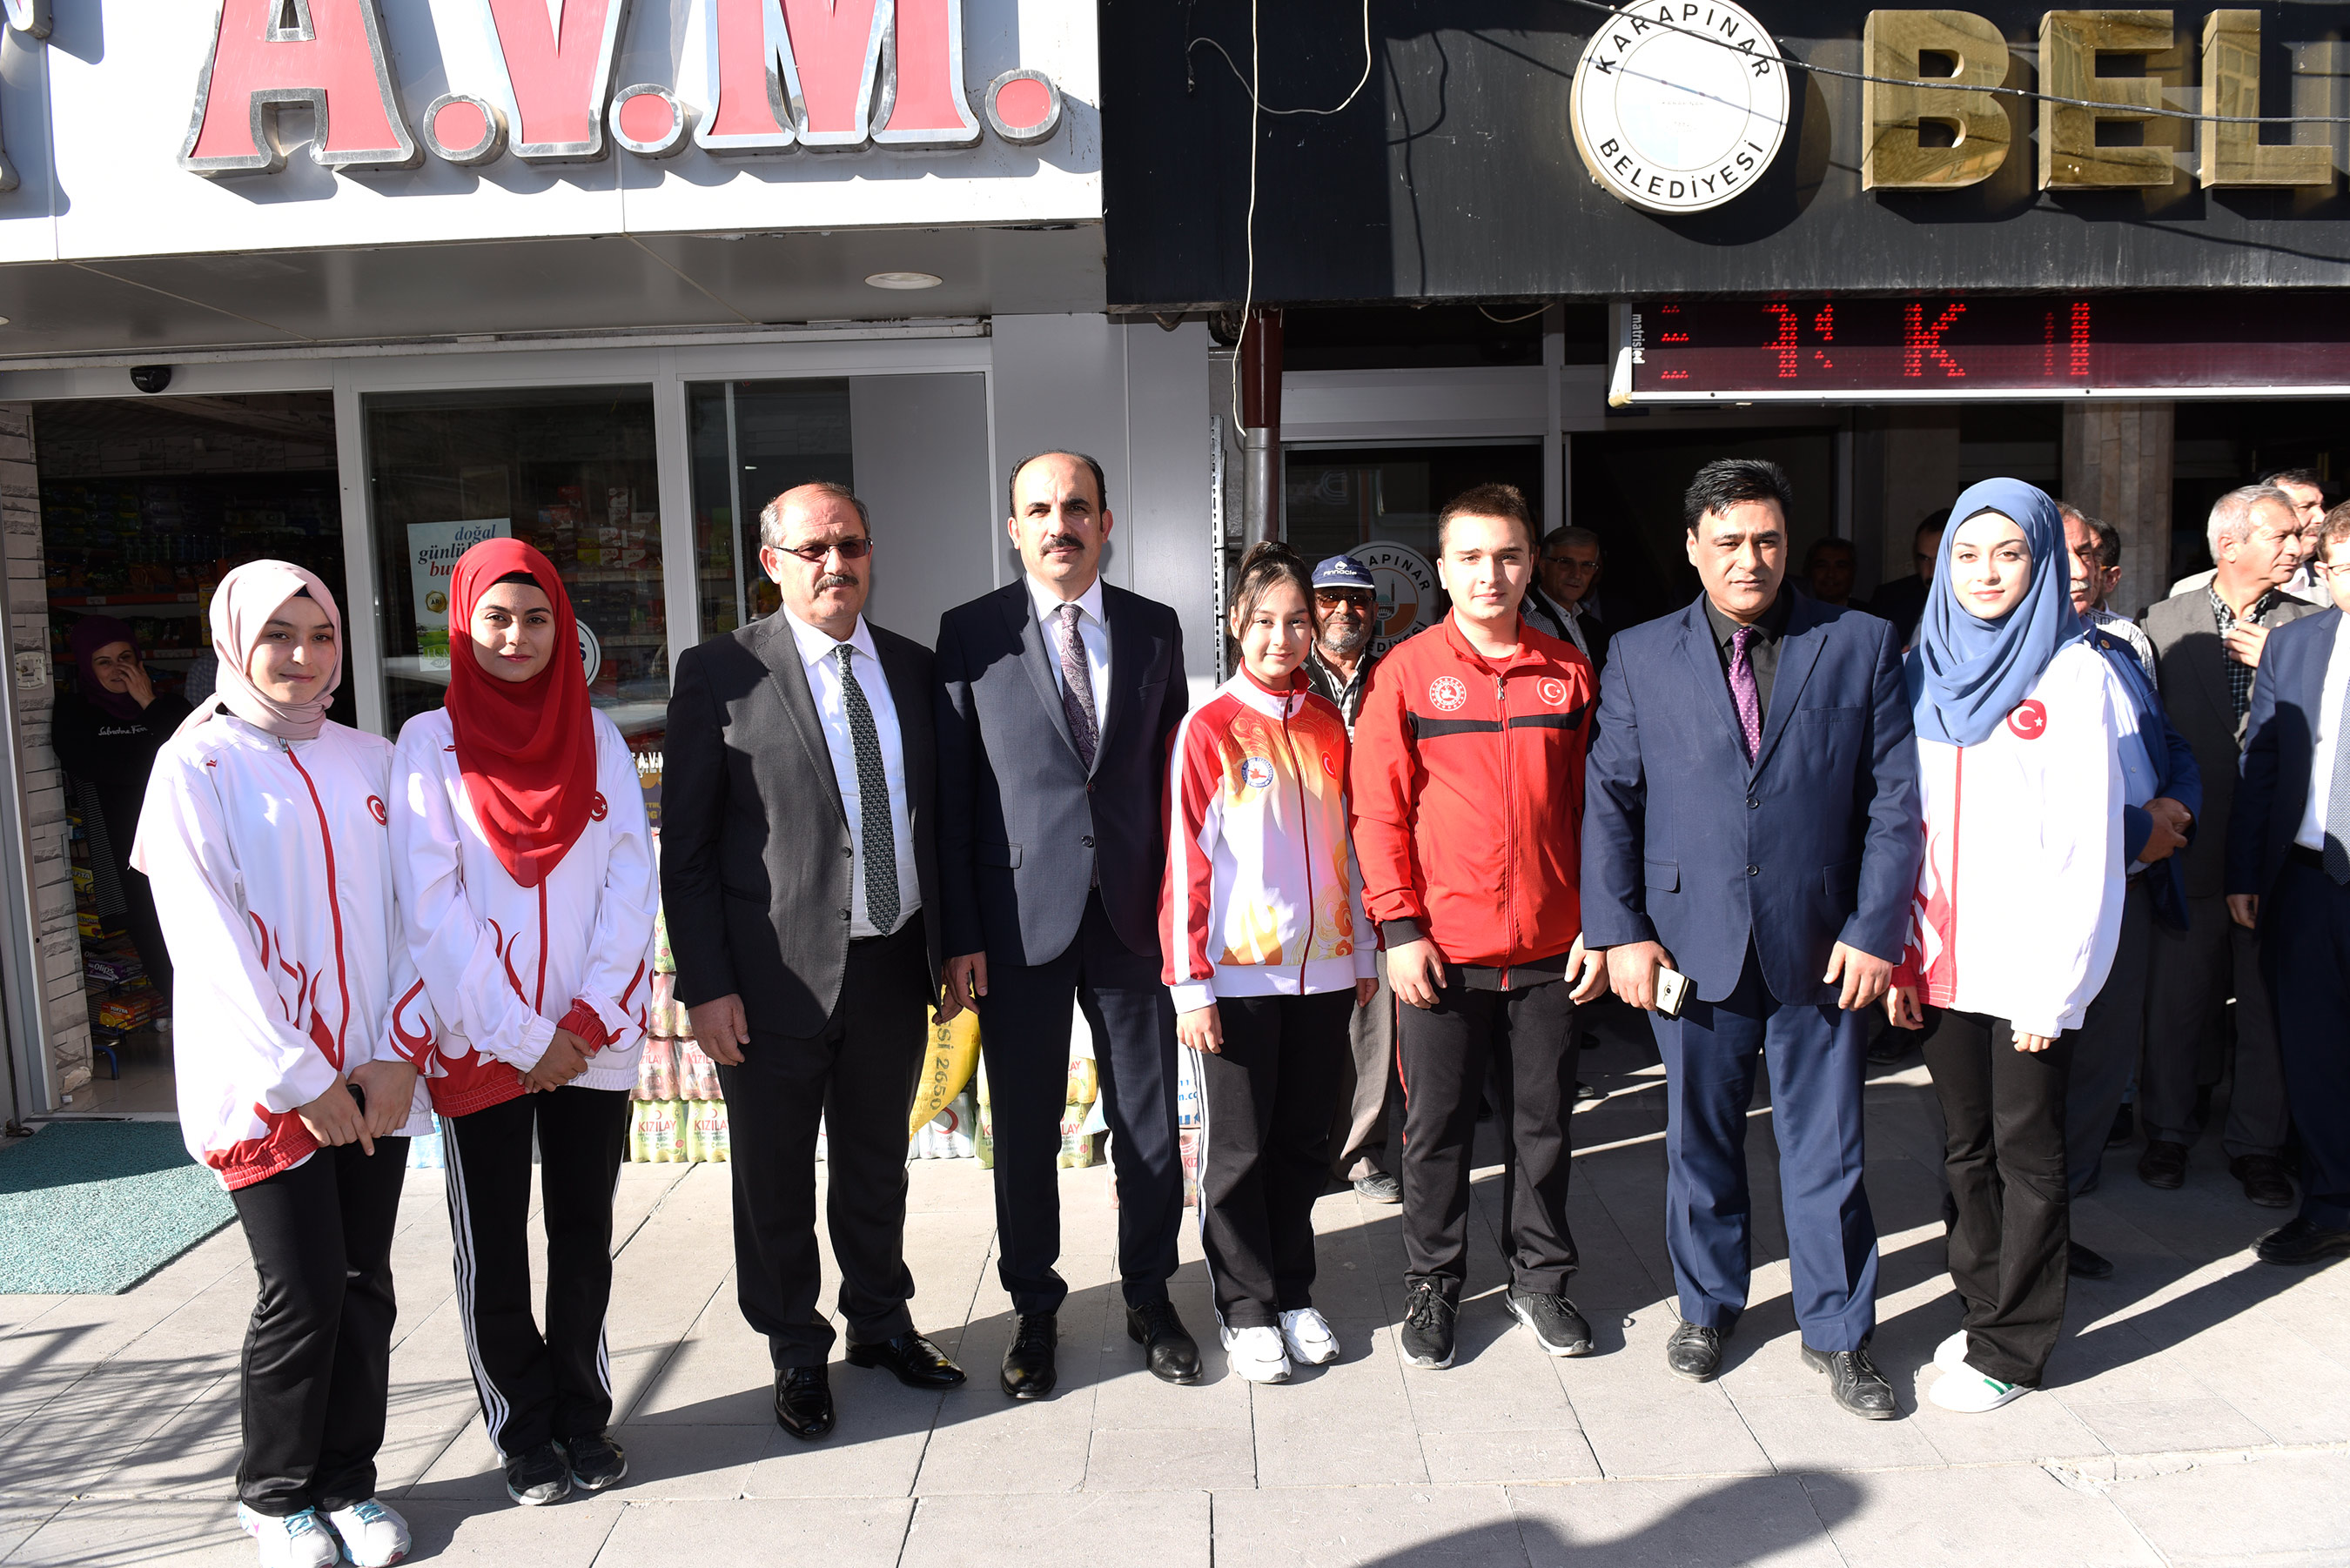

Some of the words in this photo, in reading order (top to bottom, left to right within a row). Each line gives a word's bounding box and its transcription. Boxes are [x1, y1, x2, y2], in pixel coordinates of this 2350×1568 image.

[1595, 3, 1770, 77] KARAPINAR
[1863, 9, 2333, 191] BEL
[1600, 137, 1763, 199] BELEDİYESİ
[1632, 313, 1646, 365] matrisled
[455, 524, 496, 543] doğal
[1366, 553, 1431, 592] APINAR
[641, 1055, 662, 1064] ZILAY
[930, 1056, 950, 1111] 2650
[638, 1121, 677, 1132] KIZILAY
[694, 1120, 729, 1131] KIZILA
